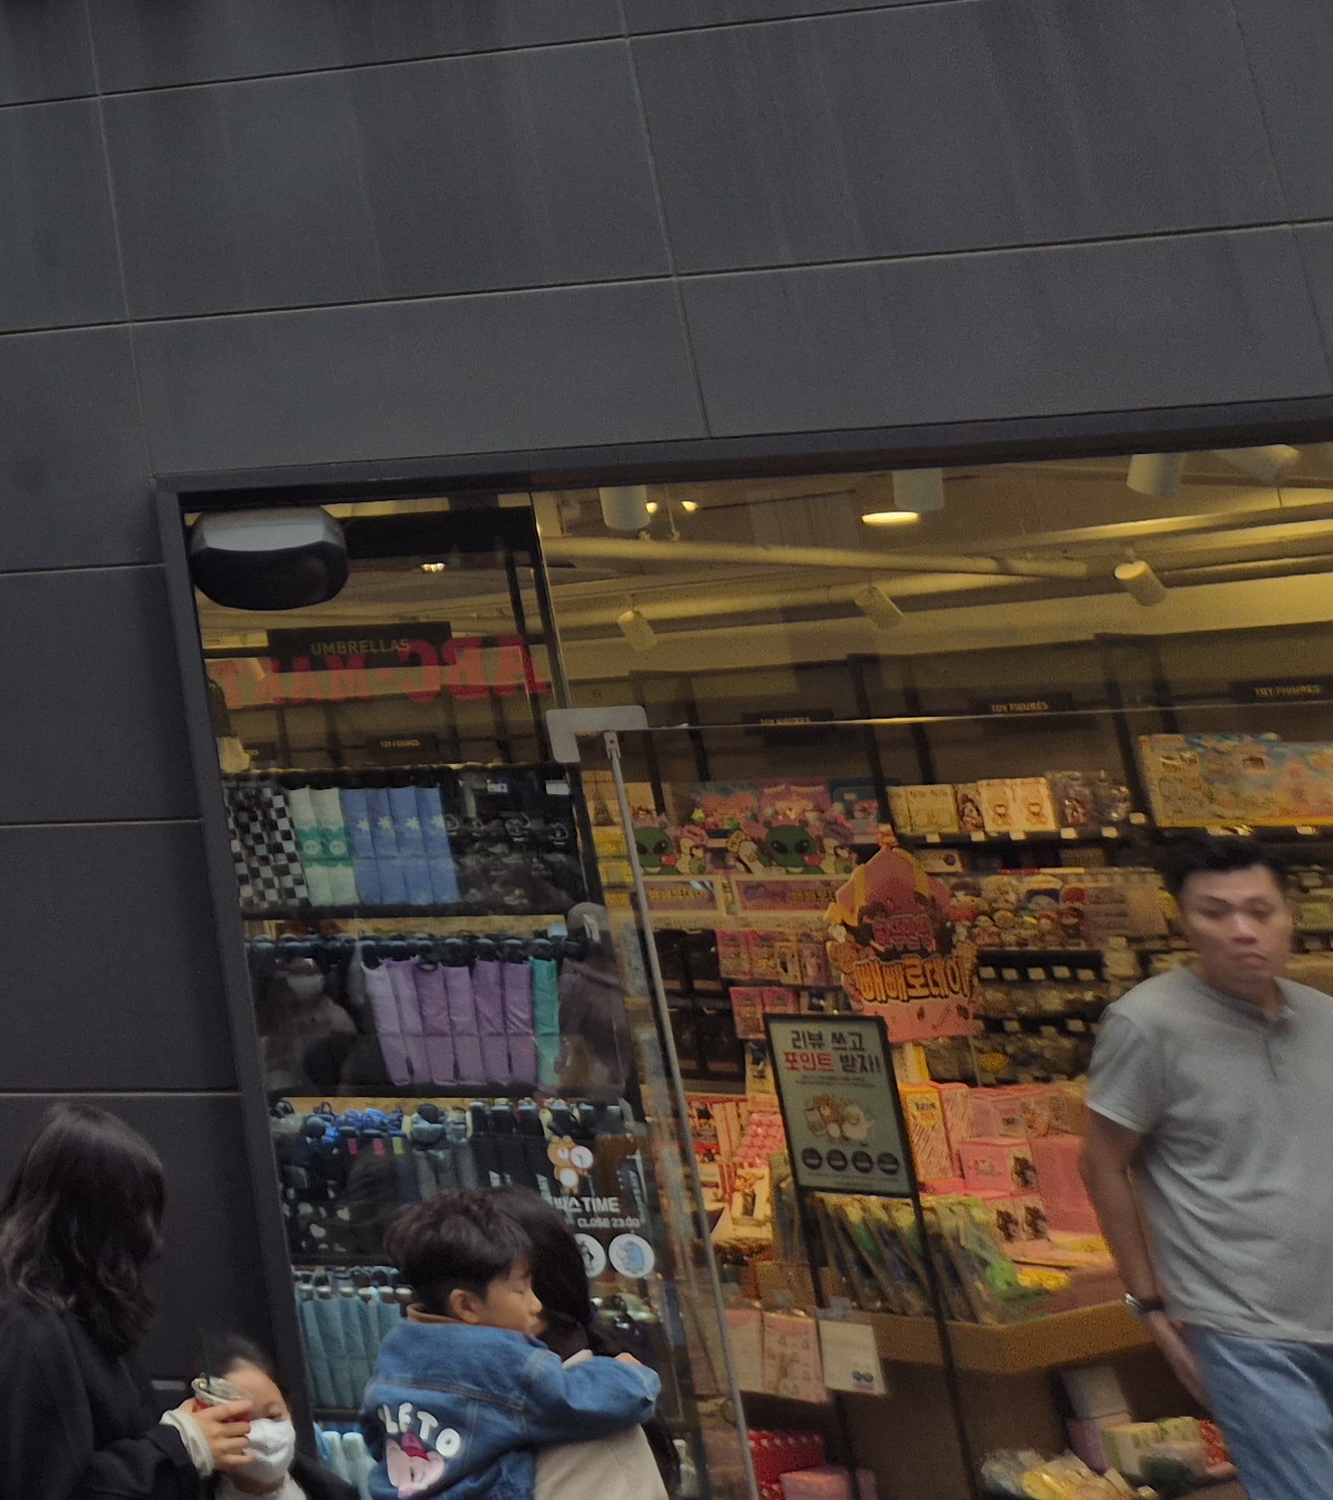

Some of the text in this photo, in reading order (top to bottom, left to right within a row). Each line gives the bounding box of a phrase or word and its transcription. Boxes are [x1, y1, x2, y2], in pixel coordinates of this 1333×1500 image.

[311, 638, 411, 656] UMBRELLAS
[854, 954, 971, 1004] 빼빼로데이
[791, 1030, 865, 1051] 리뷰 쓰고
[784, 1052, 881, 1073] 포인트 받자!
[577, 1217, 610, 1228] CLOSE
